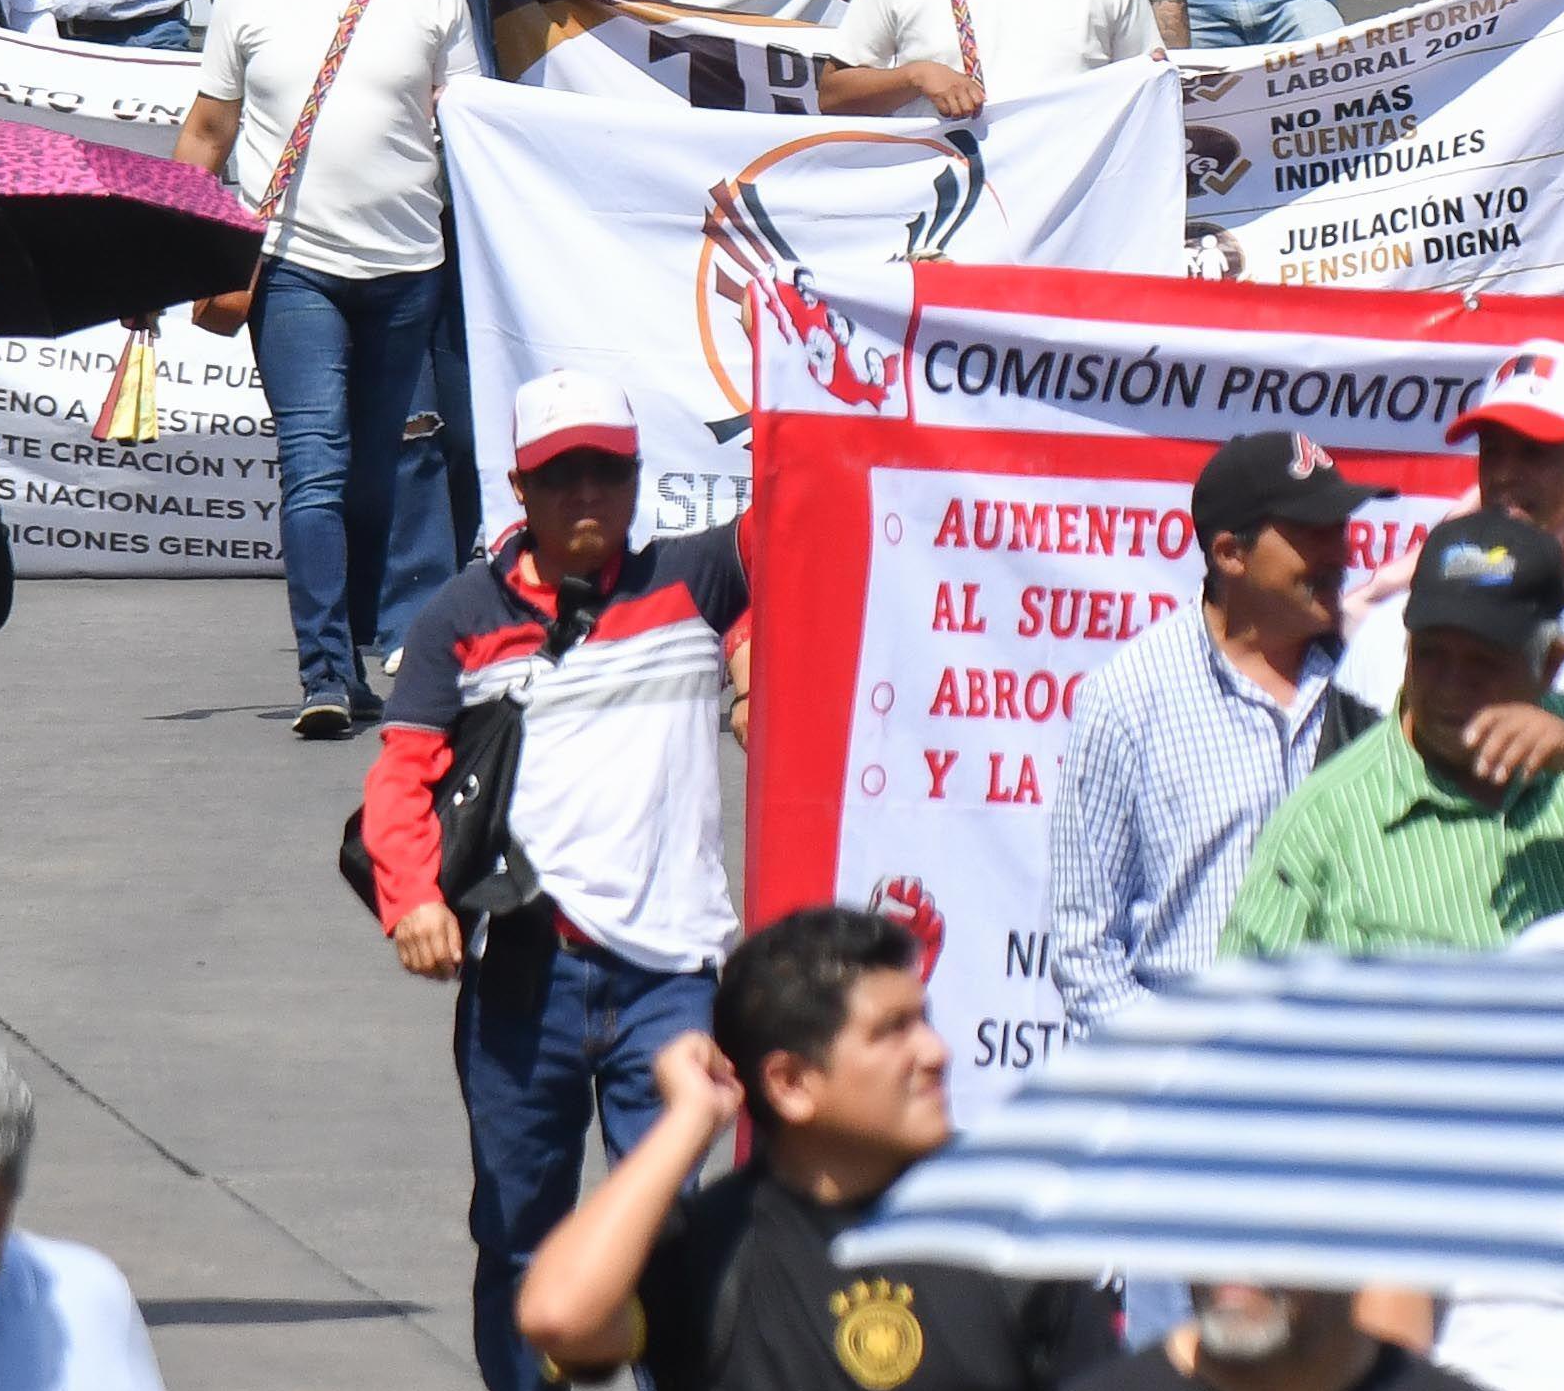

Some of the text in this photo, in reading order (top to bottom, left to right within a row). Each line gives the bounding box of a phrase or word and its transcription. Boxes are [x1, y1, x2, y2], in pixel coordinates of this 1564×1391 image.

[1266, 15, 1501, 99] LABORAL 2007
[1316, 35, 1357, 62] LA
[1270, 83, 1414, 140] NO MÁS
[1271, 114, 1418, 161] CUENTAS
[1274, 128, 1486, 193] INDIVIDUALES
[1280, 185, 1529, 256] JUBILACIÓN Y/O
[1280, 222, 1523, 287] PENSIÓN DIGNA
[924, 340, 1207, 409] COMISIÓN
[65, 400, 89, 423] A
[51, 441, 224, 478] CREACIÓN
[233, 458, 256, 479] Y
[27, 479, 246, 521] NACIONALES
[254, 500, 278, 522] Y
[159, 536, 284, 561] GENER
[933, 498, 1194, 560] AUMENTO
[932, 581, 988, 634] AL
[924, 748, 1044, 805] Y LA
[974, 1016, 1070, 1069] SIST
